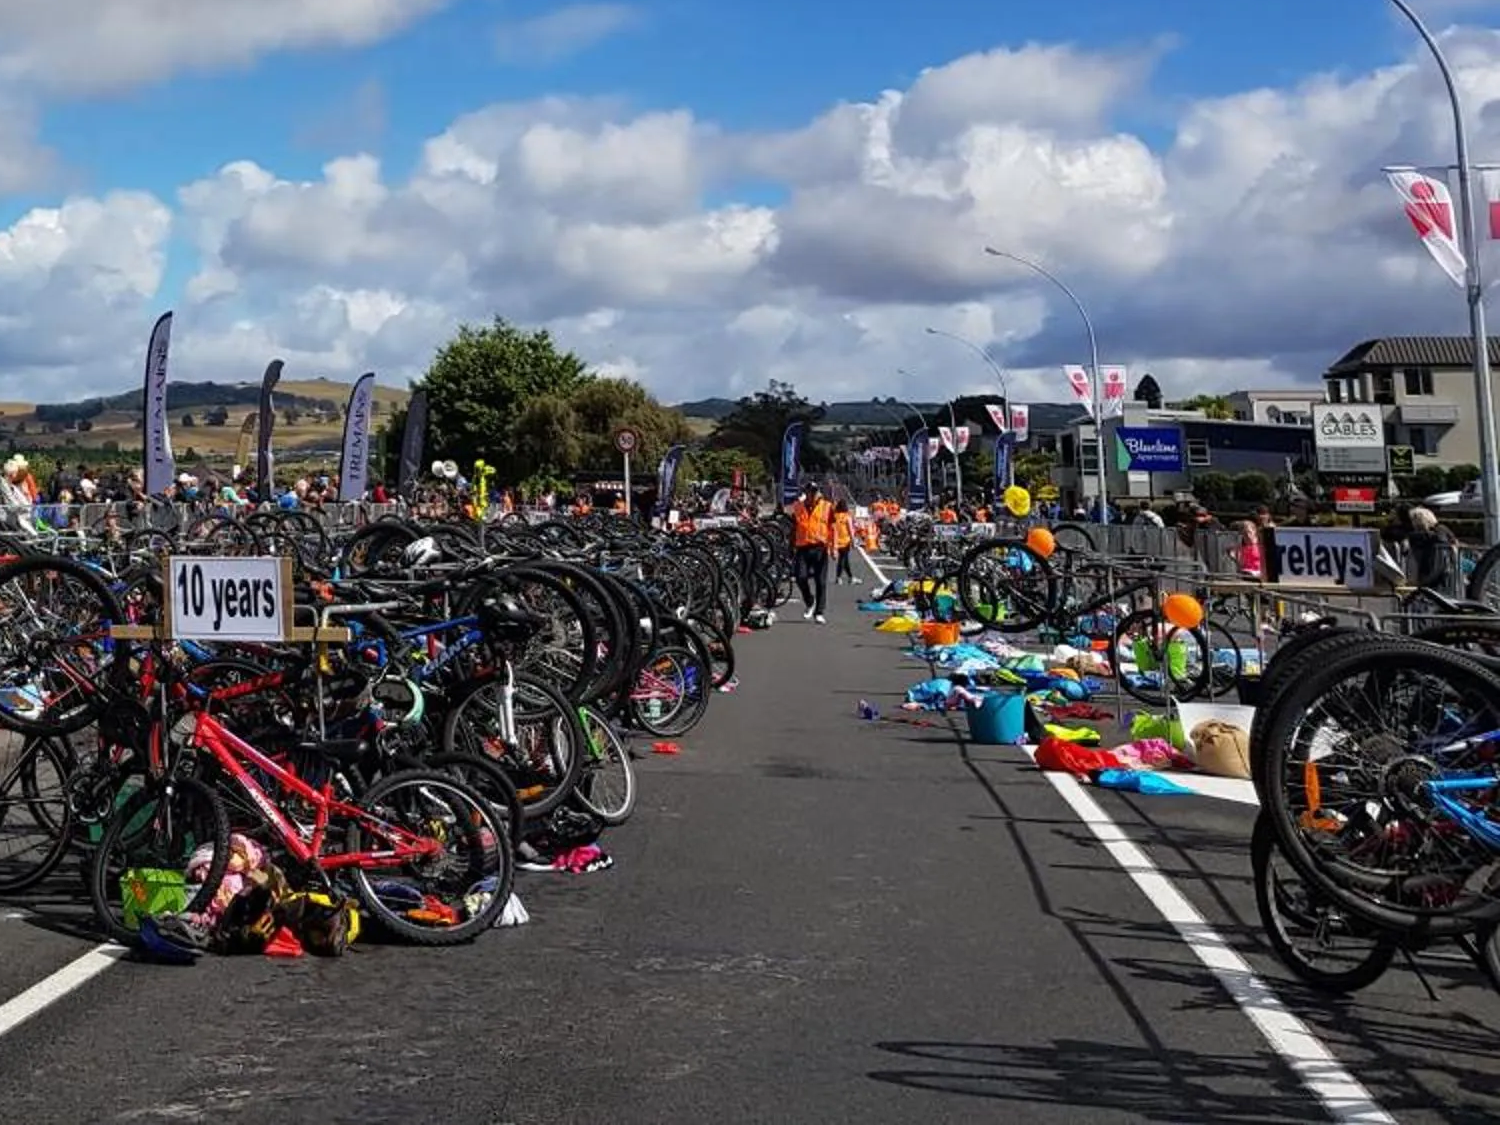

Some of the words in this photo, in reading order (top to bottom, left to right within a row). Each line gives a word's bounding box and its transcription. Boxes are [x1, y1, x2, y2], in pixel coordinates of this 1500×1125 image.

[350, 390, 367, 480] TREMAINS
[1321, 421, 1377, 436] GABLES
[1276, 535, 1366, 585] relays
[178, 563, 205, 616] 10
[211, 578, 275, 631] years
